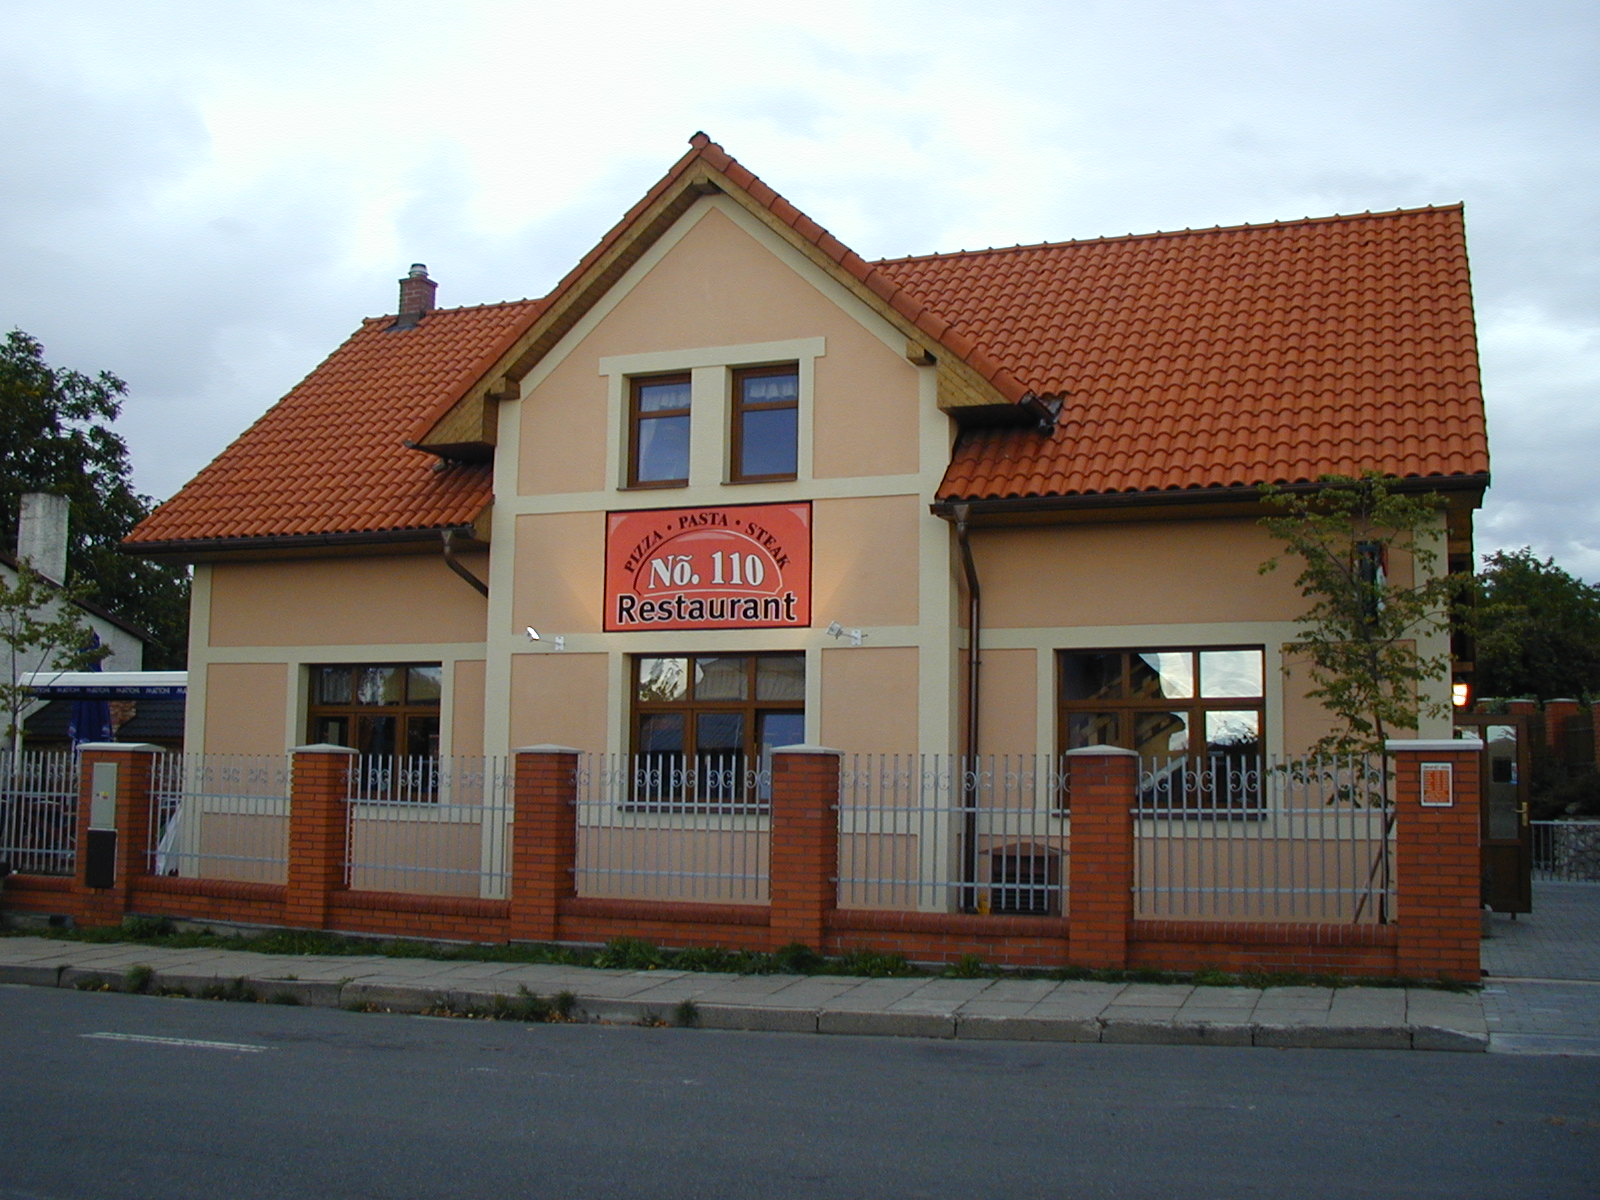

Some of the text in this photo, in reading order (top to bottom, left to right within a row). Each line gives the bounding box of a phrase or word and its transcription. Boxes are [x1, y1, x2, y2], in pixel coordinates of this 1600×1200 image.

[624, 512, 791, 571] PIZZA PASTA STEAK
[710, 550, 765, 587] 110
[617, 591, 798, 625] Restaurant
